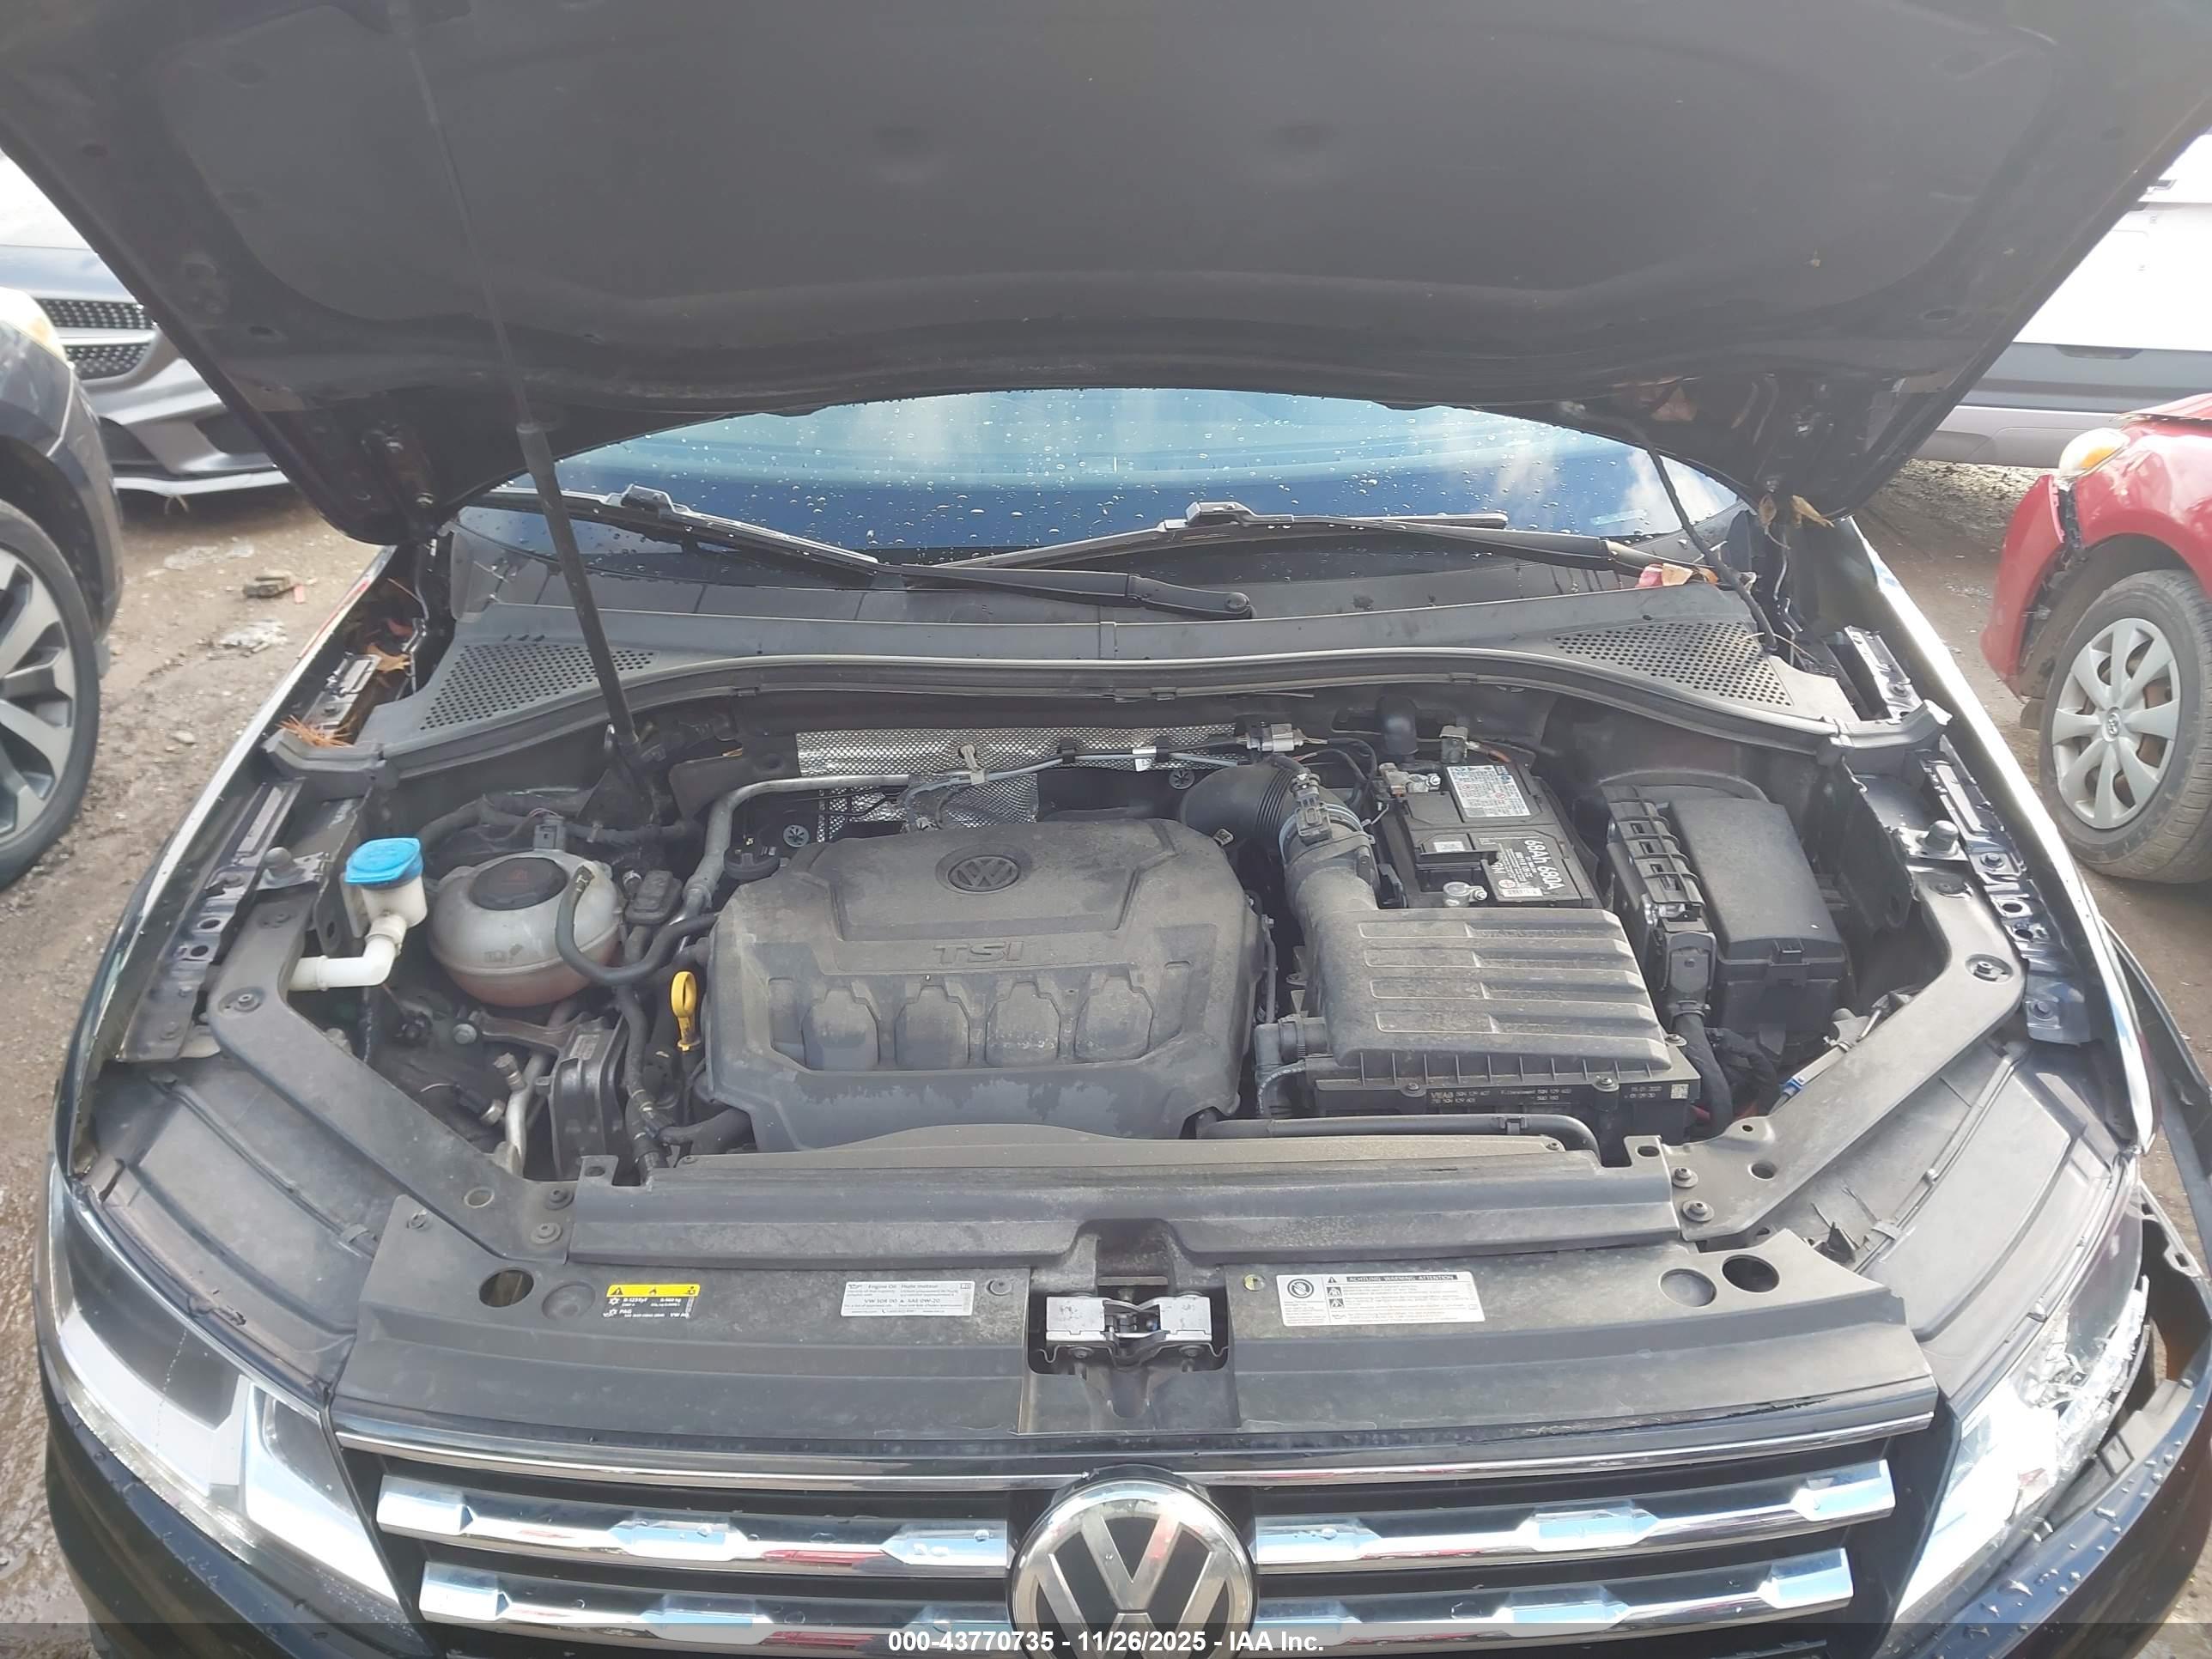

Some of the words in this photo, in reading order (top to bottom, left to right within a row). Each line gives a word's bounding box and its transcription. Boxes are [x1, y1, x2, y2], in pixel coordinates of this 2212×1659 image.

[1524, 840, 1552, 864] 68Ah
[948, 854, 1019, 892] VW
[1537, 866, 1565, 890] 680A
[933, 940, 1024, 963] TSI
